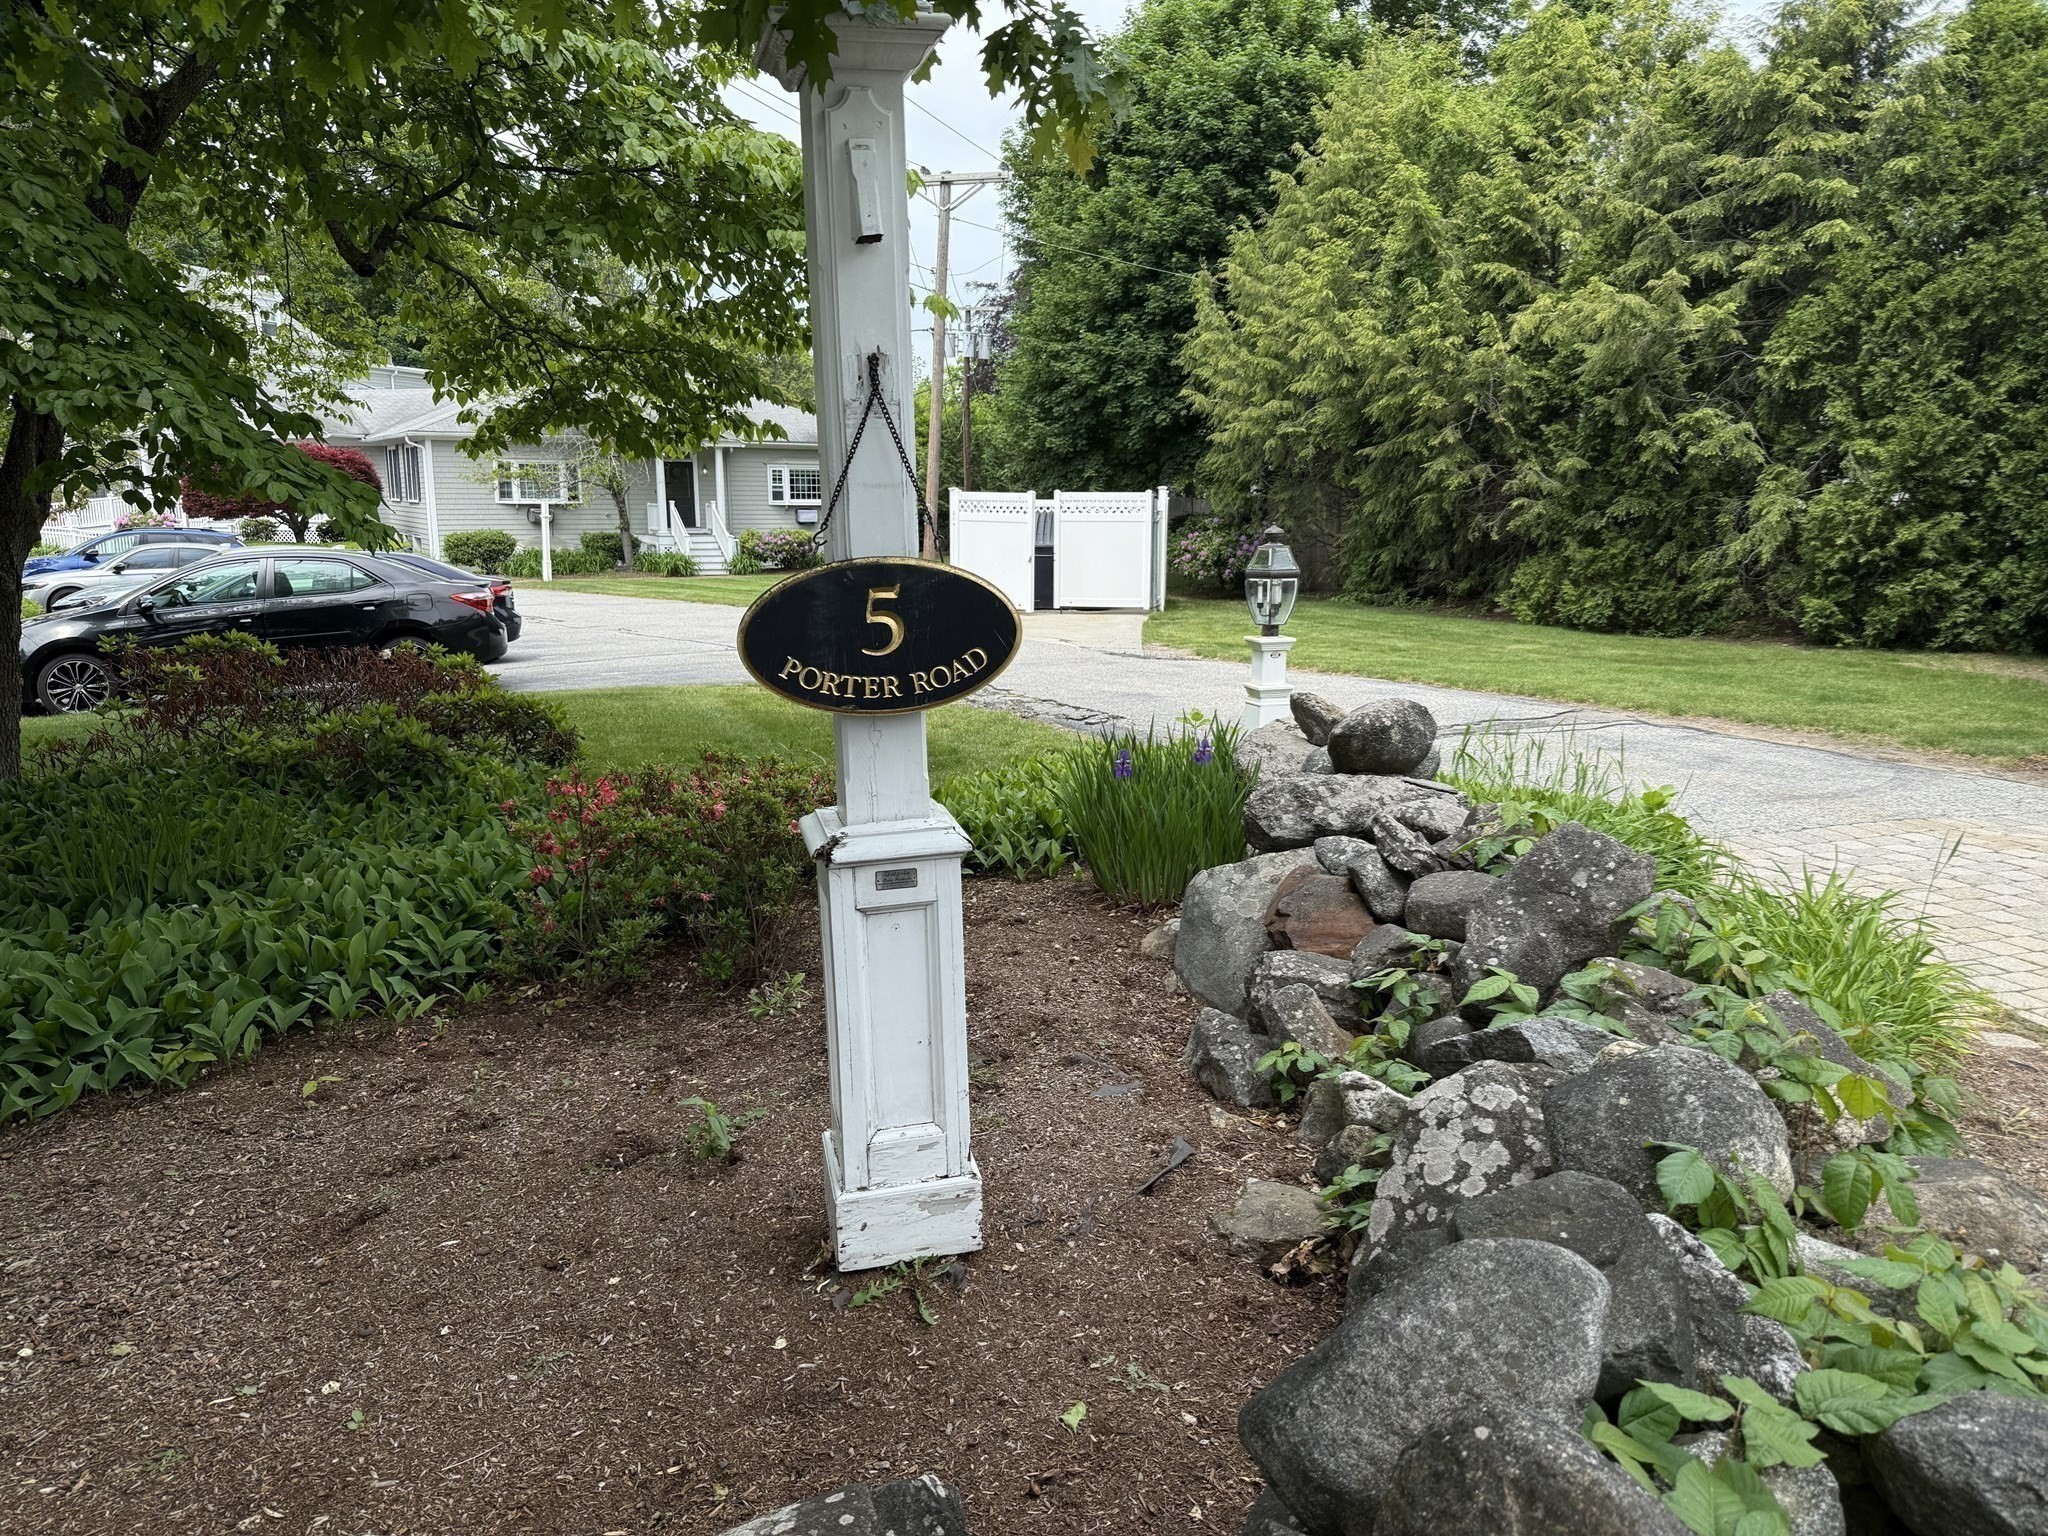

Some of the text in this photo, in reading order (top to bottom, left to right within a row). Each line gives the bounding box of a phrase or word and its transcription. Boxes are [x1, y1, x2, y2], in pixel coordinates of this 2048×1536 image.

[861, 583, 905, 657] 5
[778, 647, 989, 699] PORTER ROAD
